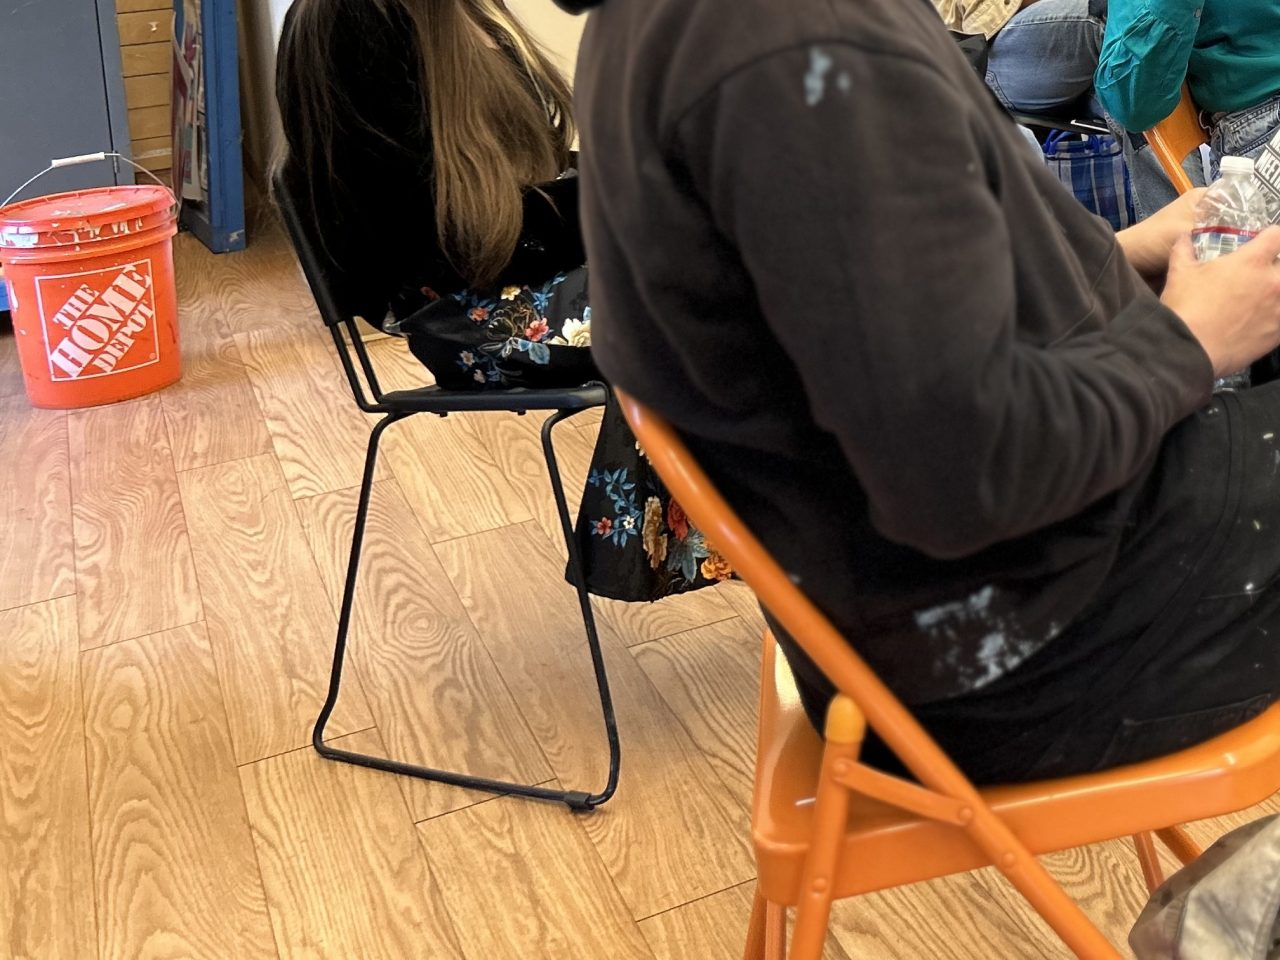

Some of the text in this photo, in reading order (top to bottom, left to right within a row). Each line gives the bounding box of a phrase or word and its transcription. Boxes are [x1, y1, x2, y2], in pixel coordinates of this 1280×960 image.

[50, 263, 151, 378] HOME
[52, 283, 101, 331] THE
[93, 299, 156, 373] DEPOT
